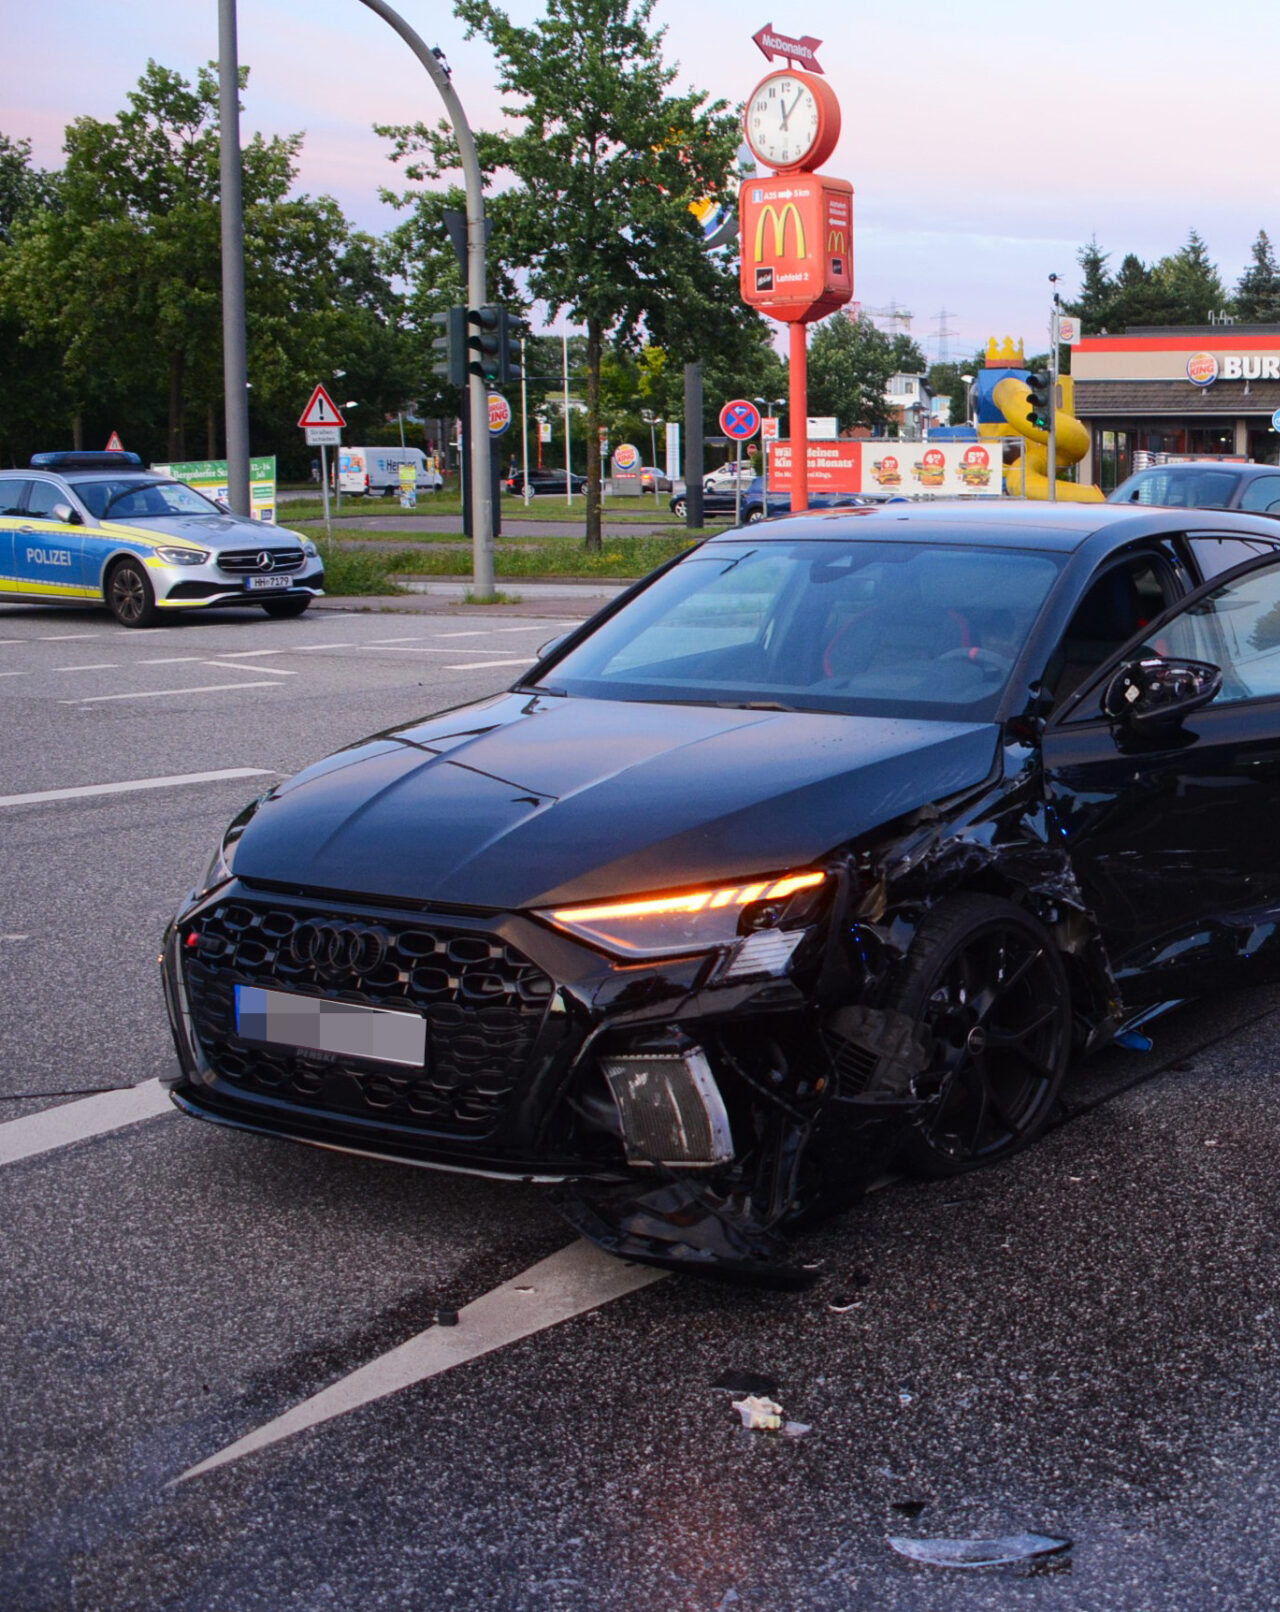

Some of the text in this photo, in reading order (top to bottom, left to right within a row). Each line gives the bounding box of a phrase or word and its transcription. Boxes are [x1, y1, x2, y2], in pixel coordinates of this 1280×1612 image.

[762, 34, 813, 59] McDonald's
[803, 272, 809, 281] 2
[1189, 363, 1215, 377] KING
[488, 408, 509, 422] ING
[775, 457, 792, 468] Kin
[26, 547, 72, 566] POLIZEI
[254, 576, 289, 587] HH 7179
